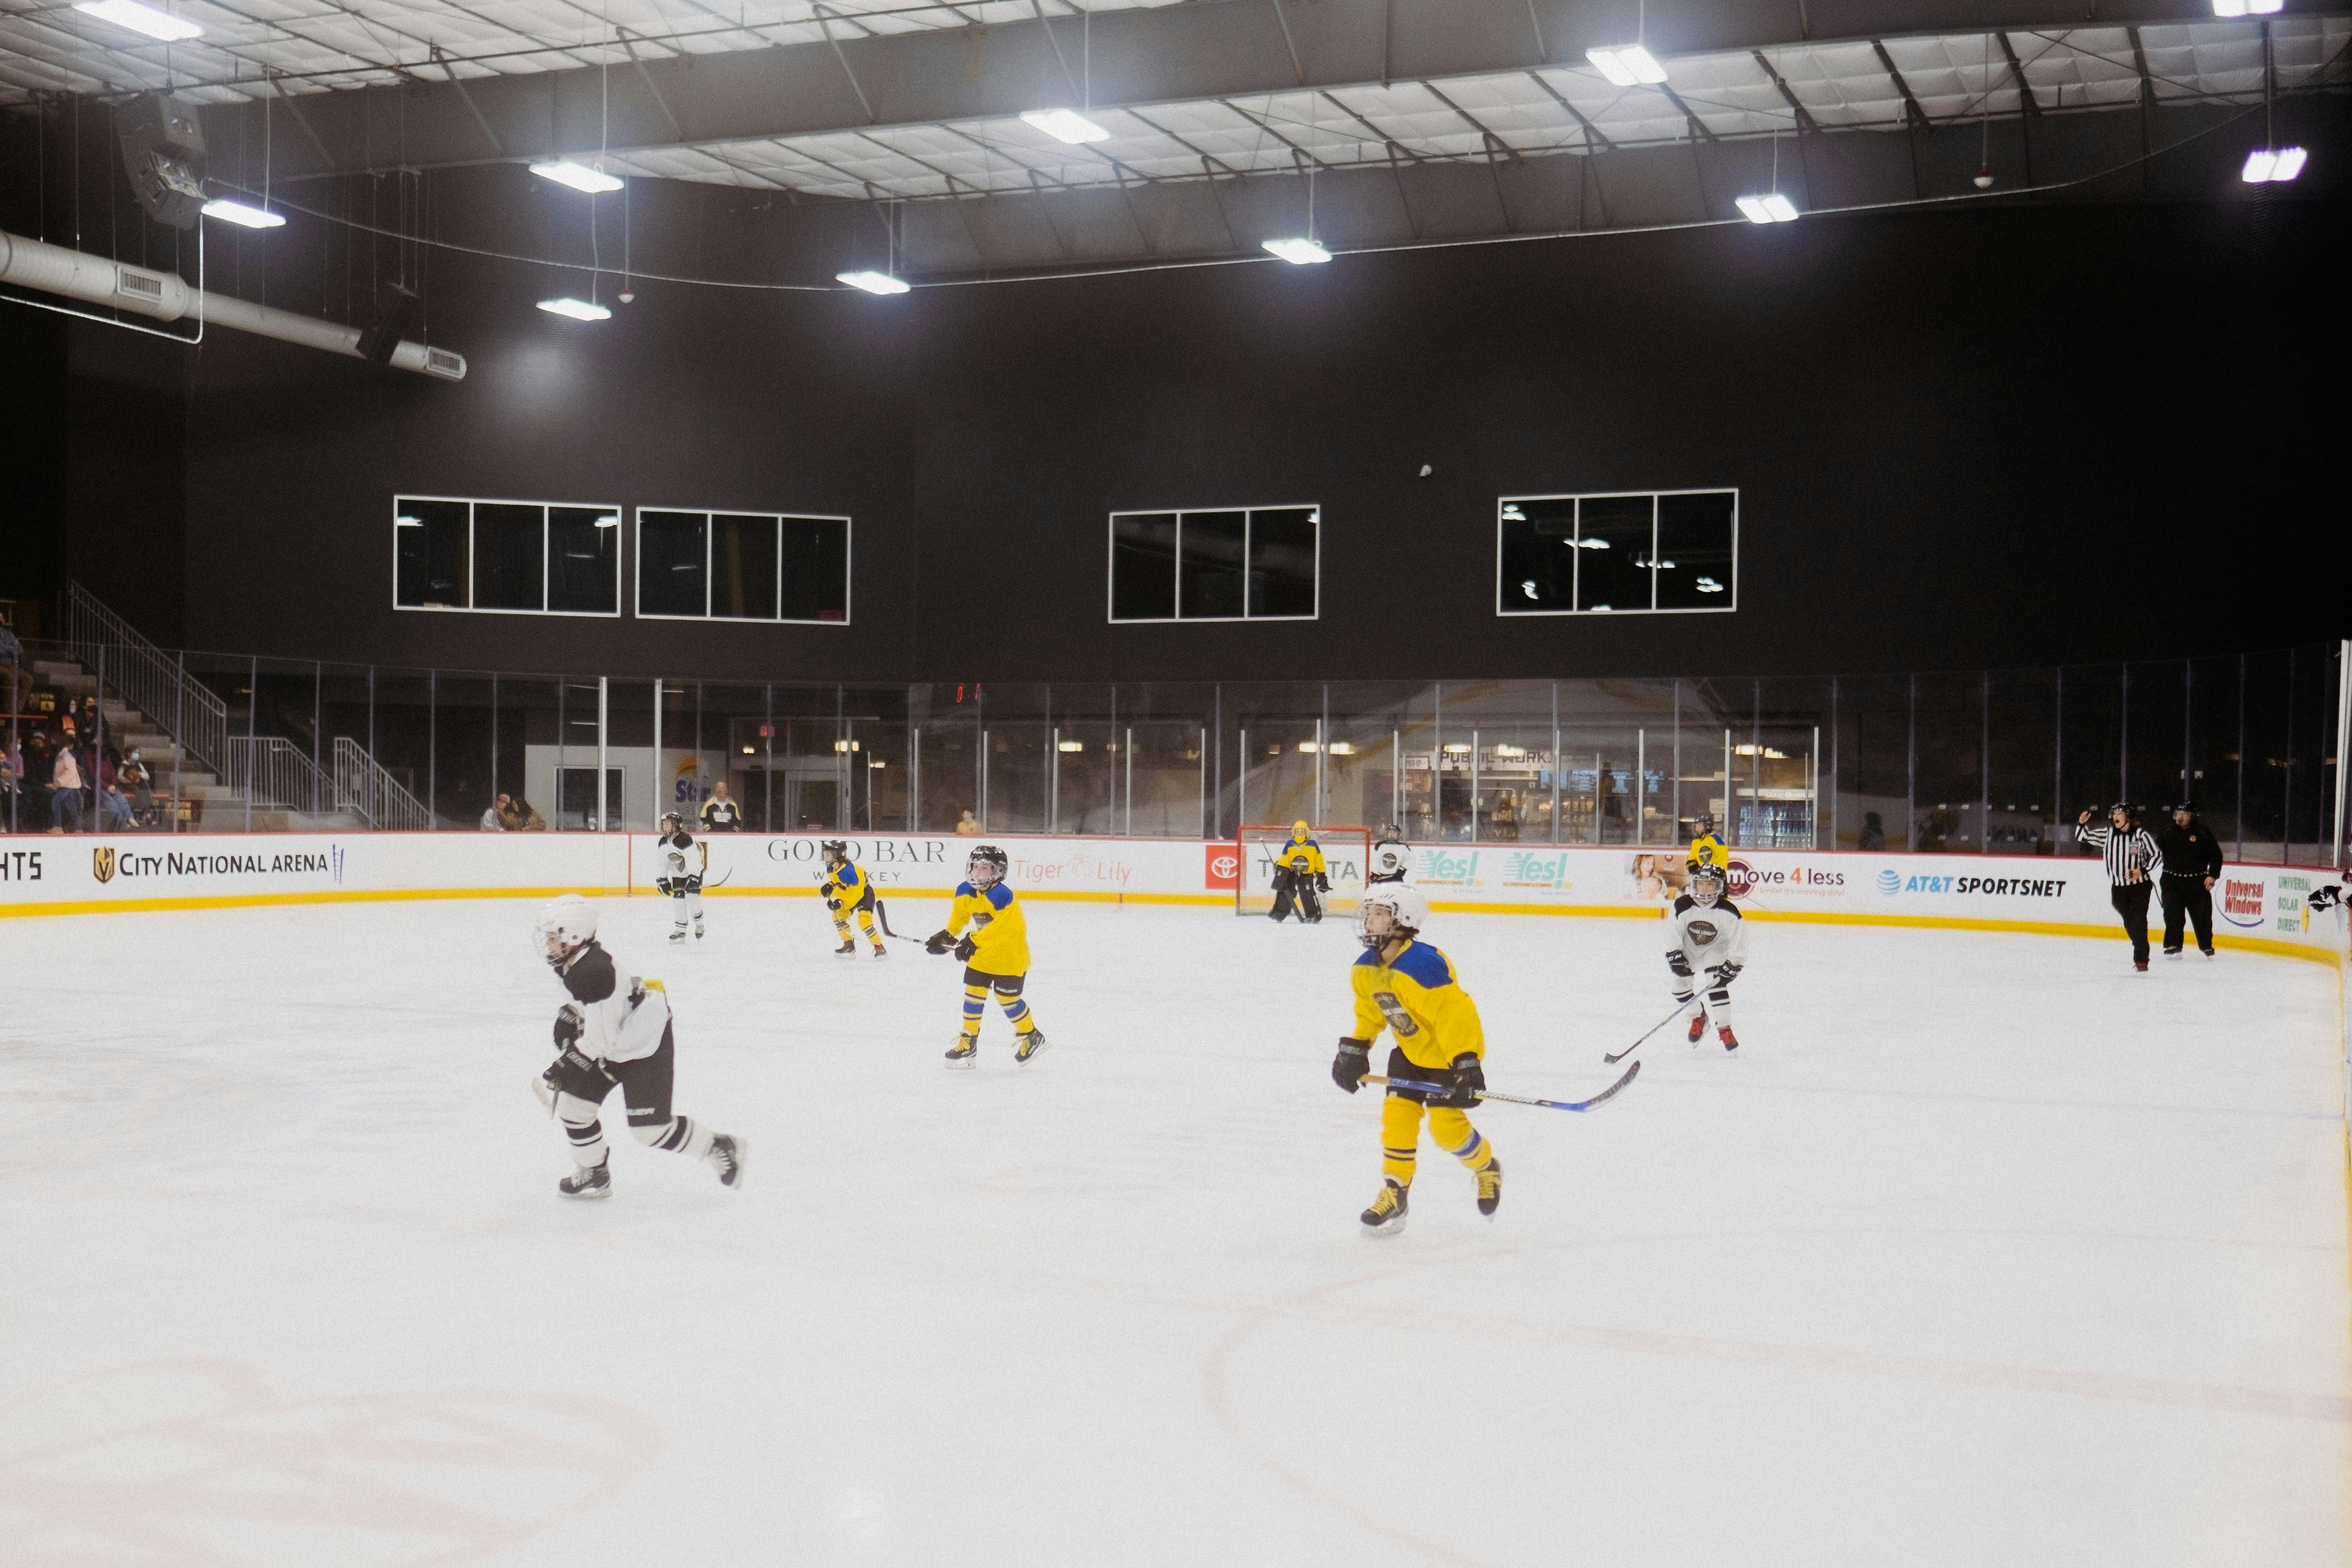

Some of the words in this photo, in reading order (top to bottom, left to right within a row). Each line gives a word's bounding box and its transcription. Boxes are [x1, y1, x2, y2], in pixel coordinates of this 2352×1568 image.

[873, 841, 945, 862] BAR
[119, 853, 163, 876] CITY
[168, 852, 267, 875] NATIONAL
[272, 854, 328, 873] ARENA
[1015, 860, 1064, 883] Tiger
[1098, 862, 1132, 885] Lily
[1426, 850, 1480, 887] Yes!
[1513, 852, 1568, 889] Yes!
[813, 871, 901, 881] WKEY
[1726, 869, 1784, 884] move
[1790, 868, 1802, 884] 4
[1808, 868, 1844, 885] less
[2278, 876, 2311, 892] UNIVERSAL
[1796, 888, 1825, 897] moving
[1905, 876, 1954, 893] AT&T
[1957, 877, 2066, 897] SPORTSNET
[2225, 879, 2264, 898] Universal
[2278, 897, 2299, 912] SOLAR
[2277, 917, 2300, 932] DIRECT
